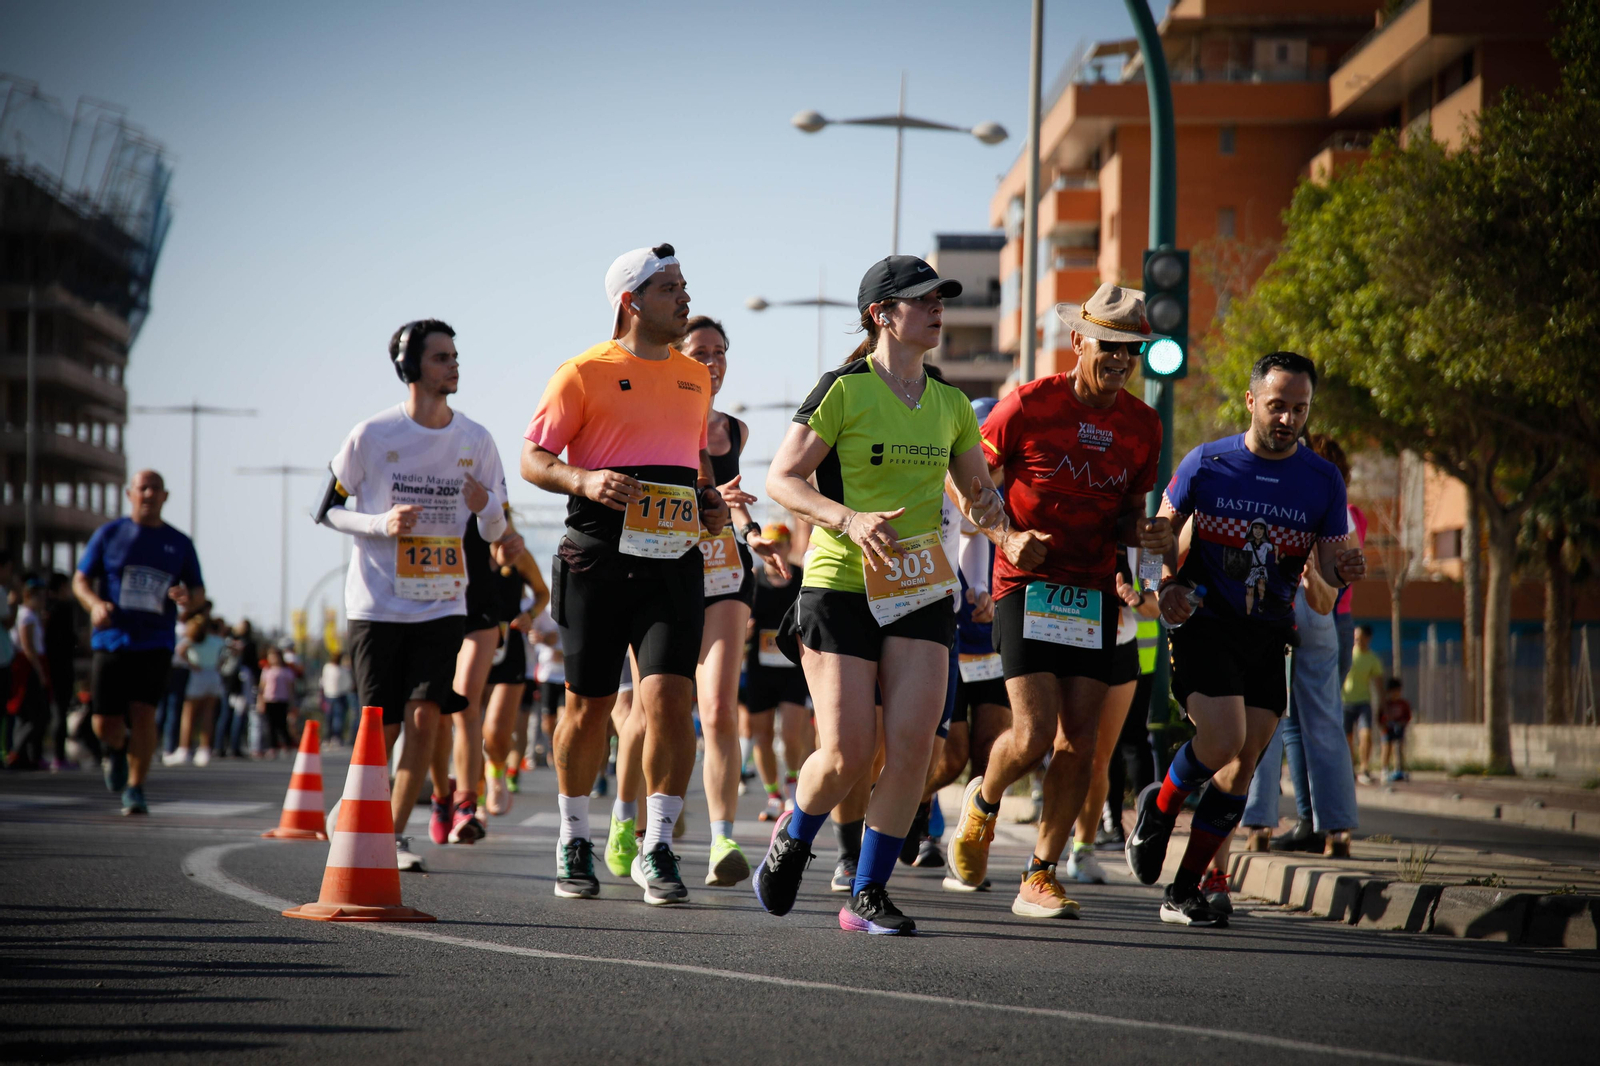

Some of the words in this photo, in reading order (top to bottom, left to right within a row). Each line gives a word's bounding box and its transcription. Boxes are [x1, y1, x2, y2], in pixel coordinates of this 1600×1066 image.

[1078, 421, 1096, 435] XIII
[392, 472, 423, 483] Medio
[391, 482, 434, 496] Almería
[638, 495, 693, 522] 1178
[1216, 497, 1307, 523] BASTITANIA
[657, 520, 674, 528] FACU
[405, 546, 458, 567] 1218
[883, 549, 935, 581] 303
[1044, 583, 1089, 609] 705
